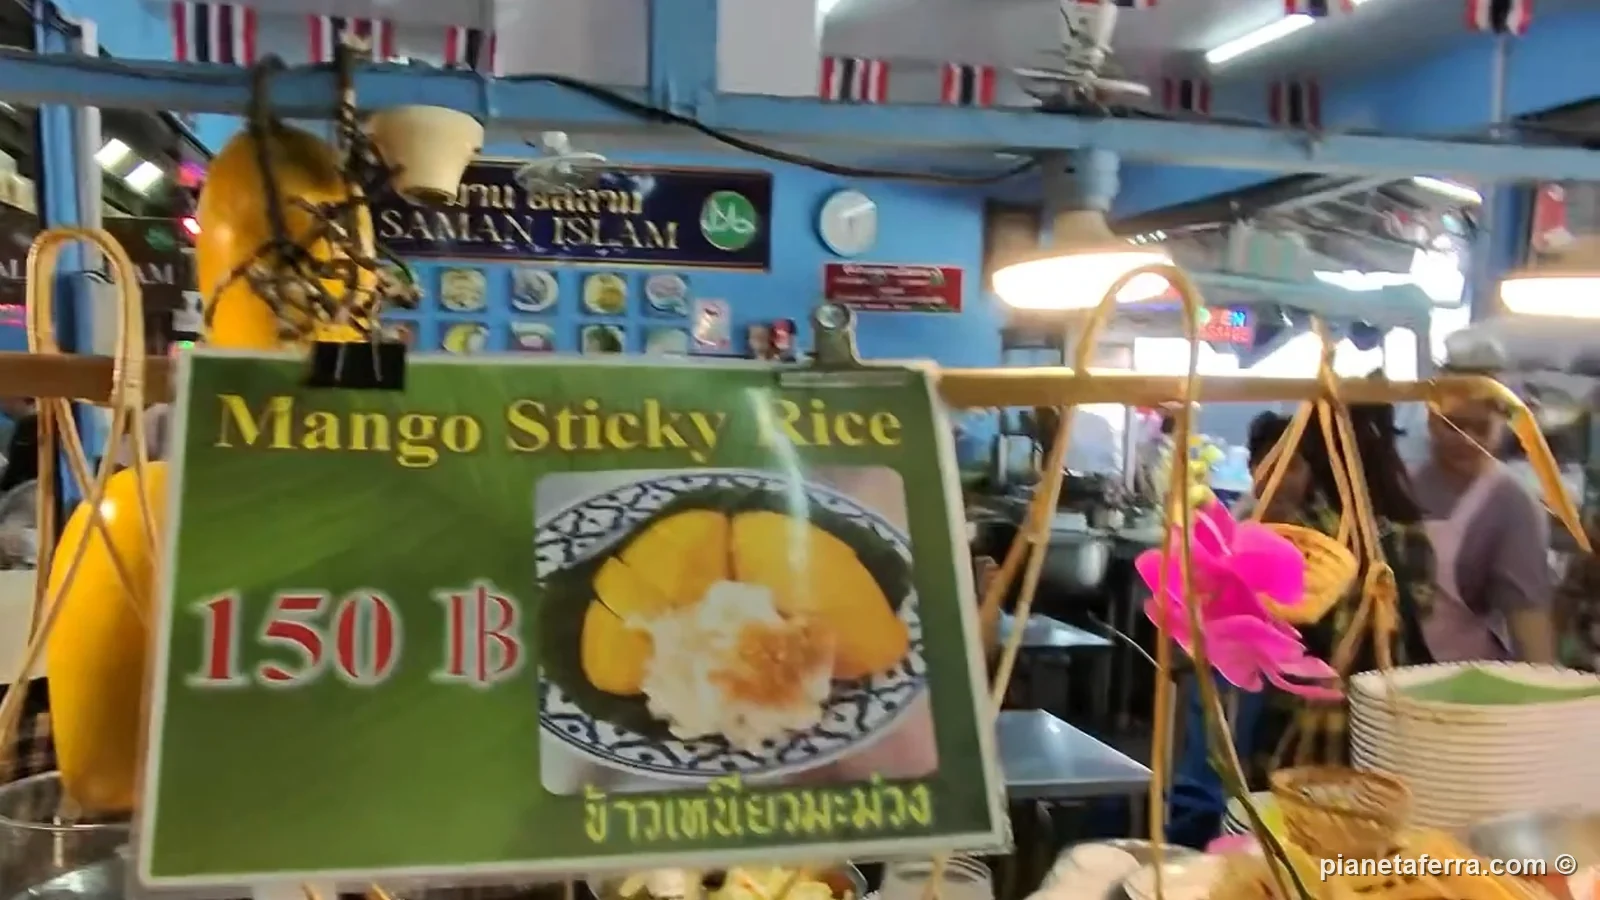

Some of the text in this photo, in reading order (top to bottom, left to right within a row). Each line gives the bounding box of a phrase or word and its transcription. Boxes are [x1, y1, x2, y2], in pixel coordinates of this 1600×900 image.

[379, 209, 535, 251] SAMAN
[551, 213, 680, 250] ISLAM
[213, 393, 903, 468] Mango Sticky Rice
[186, 587, 400, 689] 150
[583, 773, 933, 844] ข้าวเหนียวมะม่วง
